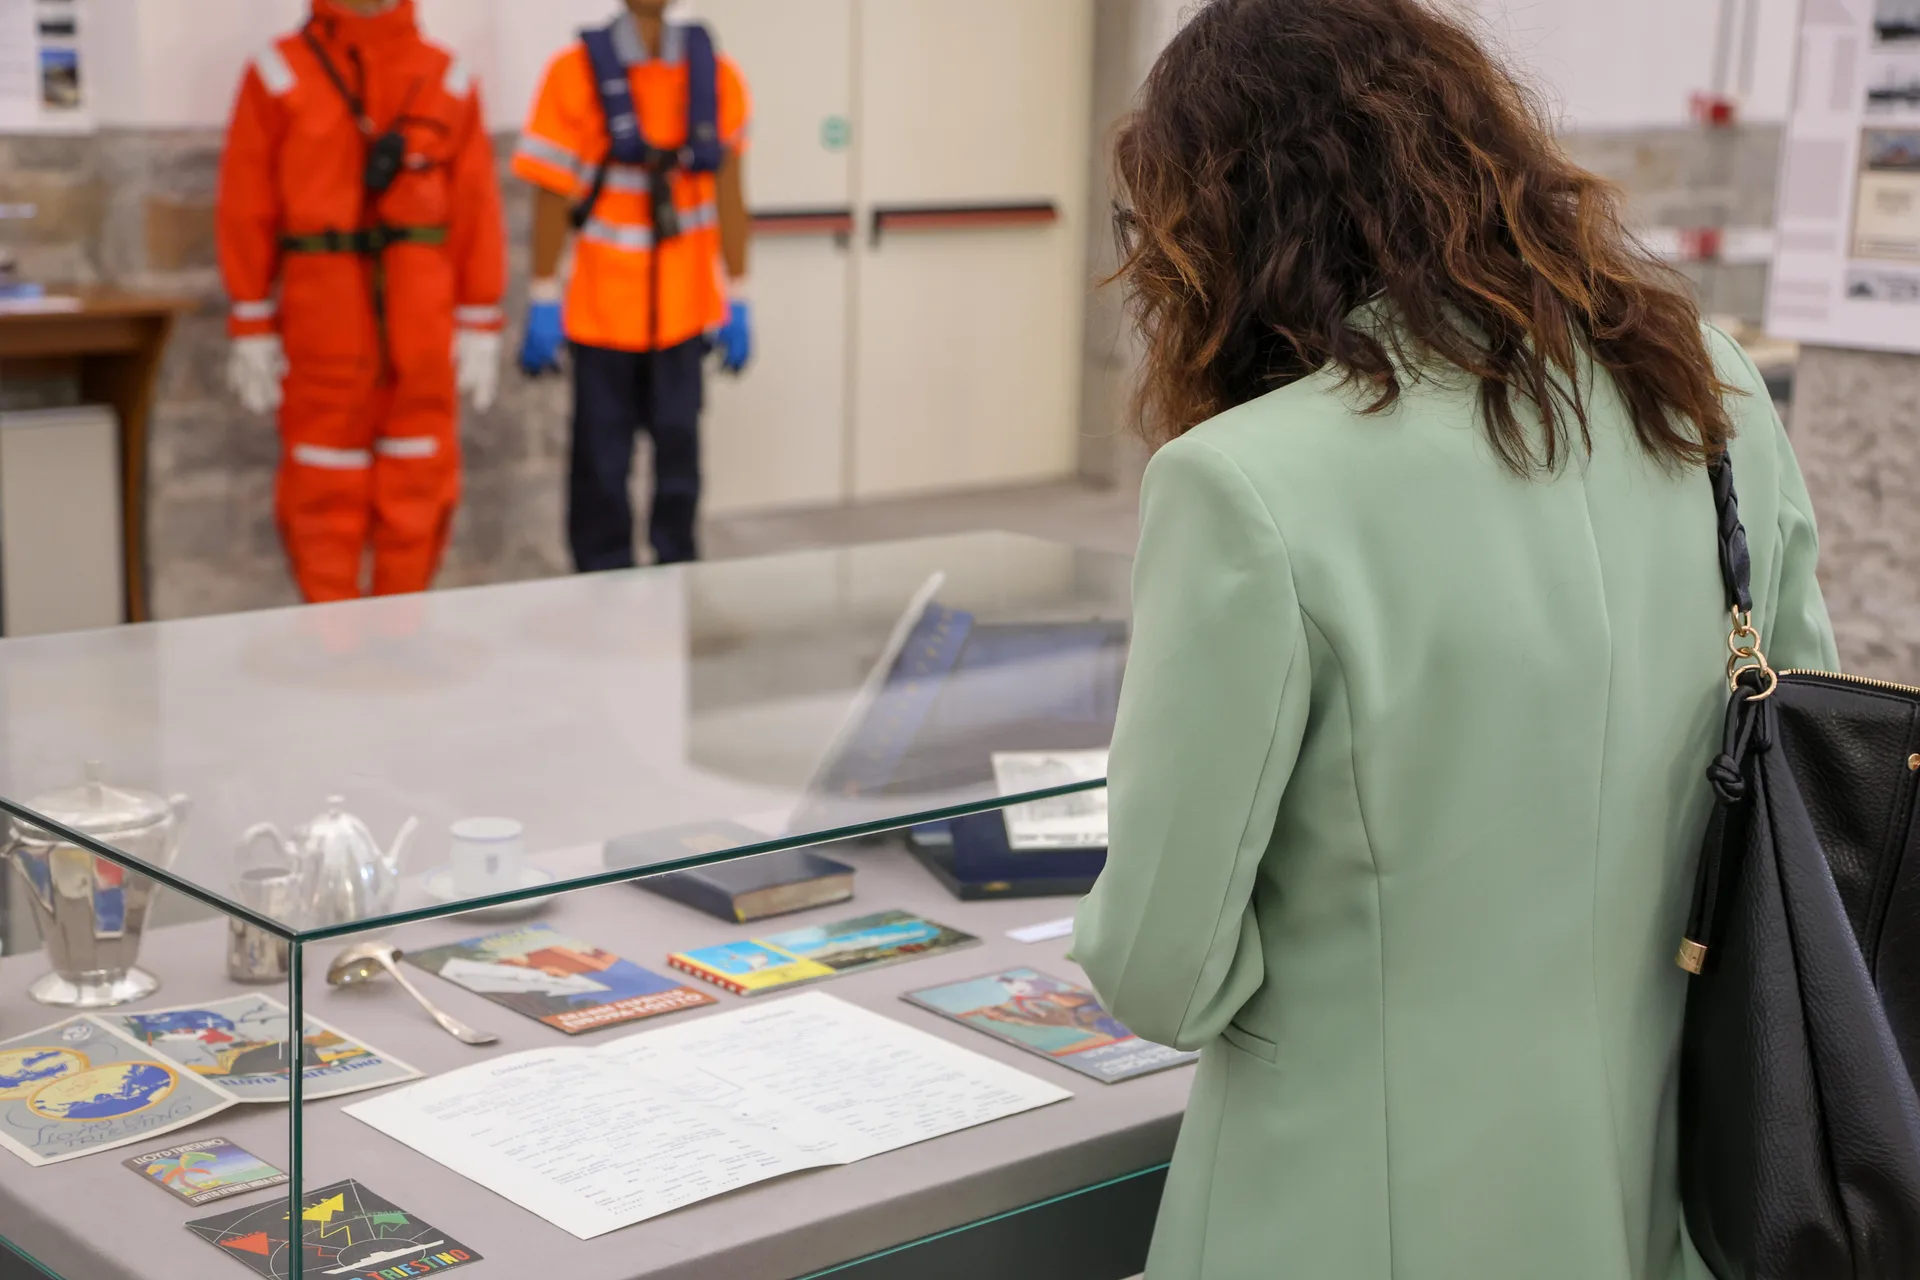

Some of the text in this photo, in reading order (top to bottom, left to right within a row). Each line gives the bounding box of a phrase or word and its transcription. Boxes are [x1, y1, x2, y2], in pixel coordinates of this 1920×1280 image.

[132, 1138, 226, 1165] LLOYD TRIESTINO
[366, 1249, 470, 1280] TRIESTINO
